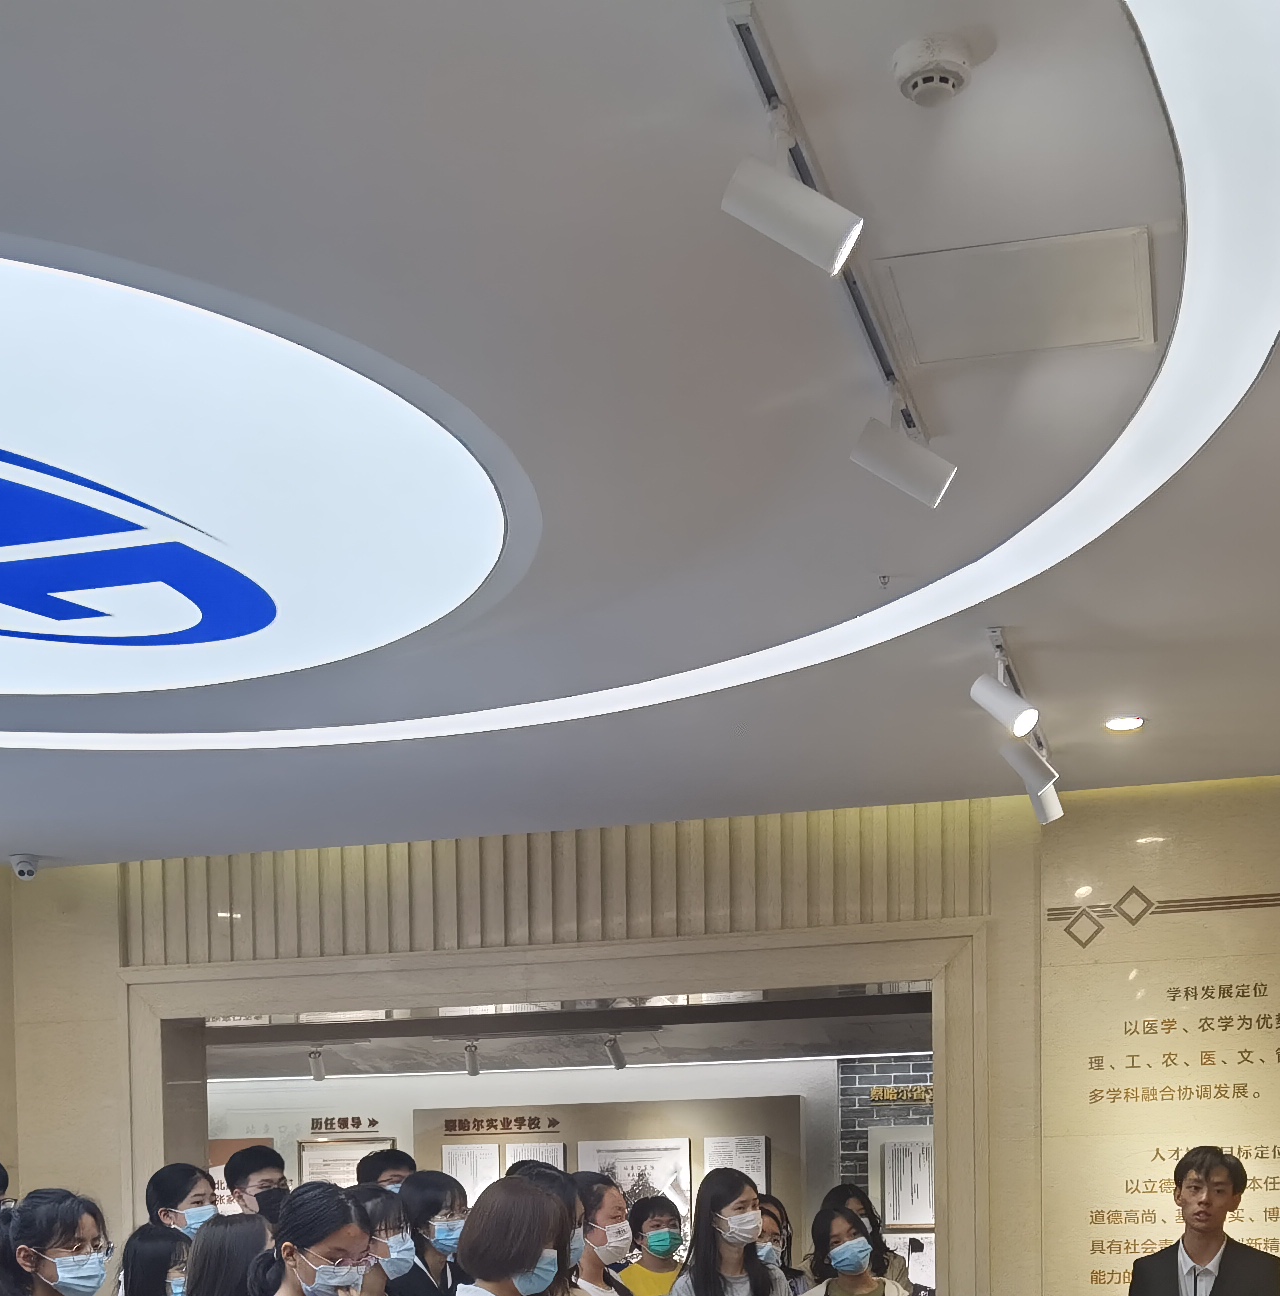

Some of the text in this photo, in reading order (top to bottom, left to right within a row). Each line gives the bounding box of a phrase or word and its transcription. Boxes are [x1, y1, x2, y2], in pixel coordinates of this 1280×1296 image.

[1166, 982, 1269, 1002] 学科发展定位
[1088, 1083, 1261, 1105] 多学科融合协调发展。
[310, 1116, 363, 1131] 历任领导
[444, 1116, 541, 1132] 察哈尔实业学校
